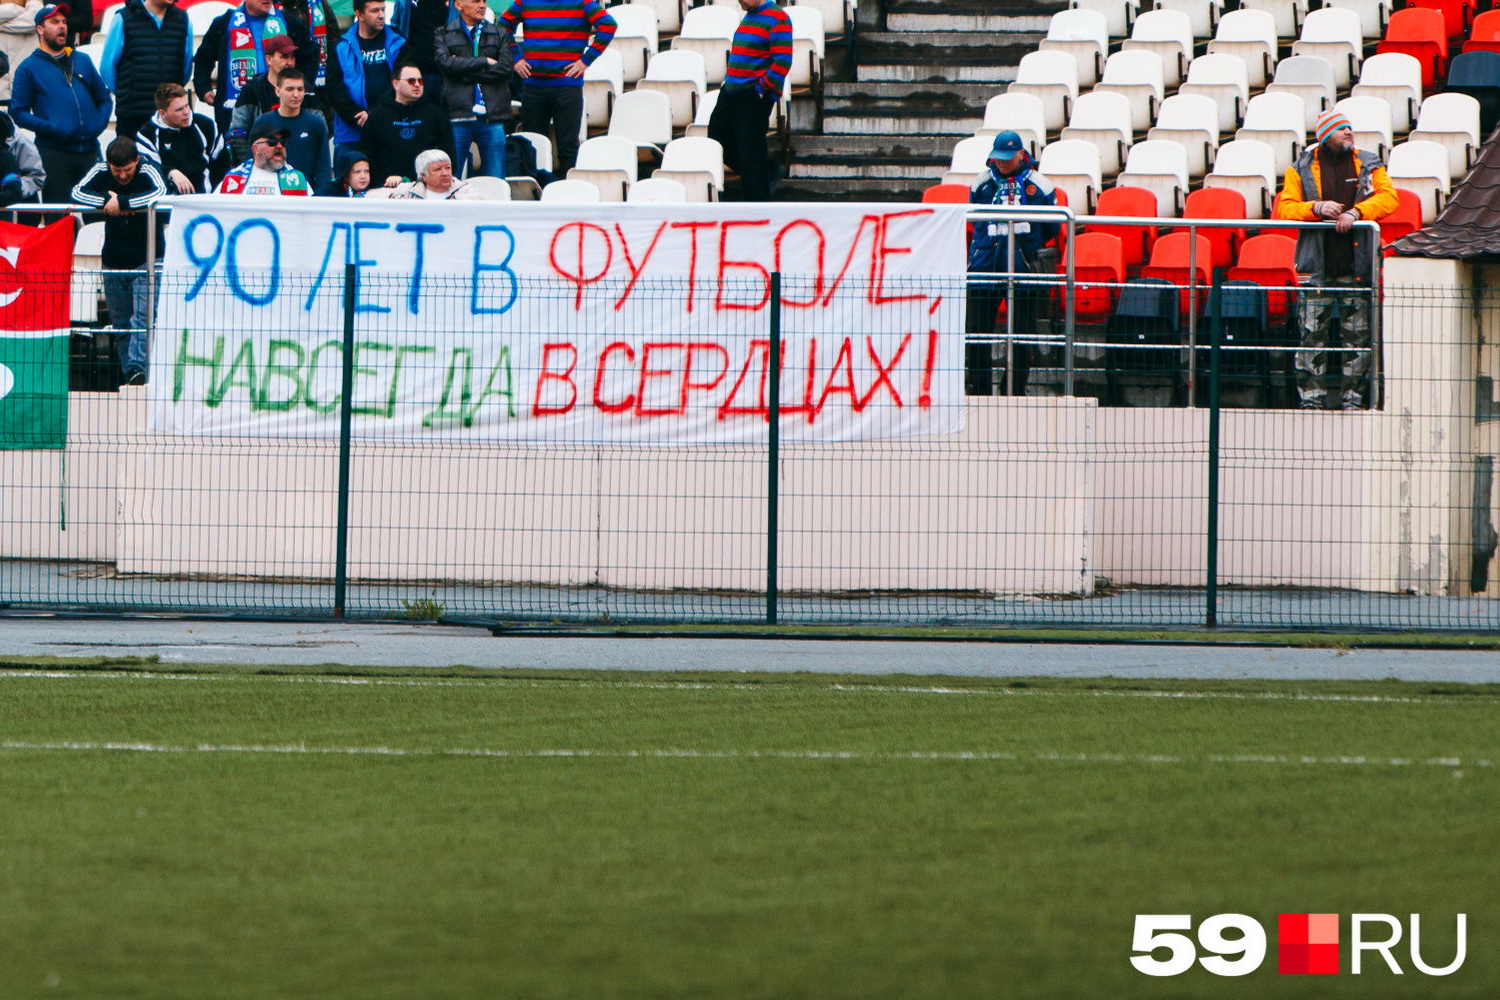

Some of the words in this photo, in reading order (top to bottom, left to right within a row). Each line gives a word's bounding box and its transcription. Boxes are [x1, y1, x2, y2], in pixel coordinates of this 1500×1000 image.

[183, 214, 281, 306] 90
[304, 221, 445, 314] ЛЕТ
[470, 224, 518, 315] В
[549, 208, 943, 316] ФУТБОЛЕ,
[172, 328, 517, 428] НАВСЕГДА
